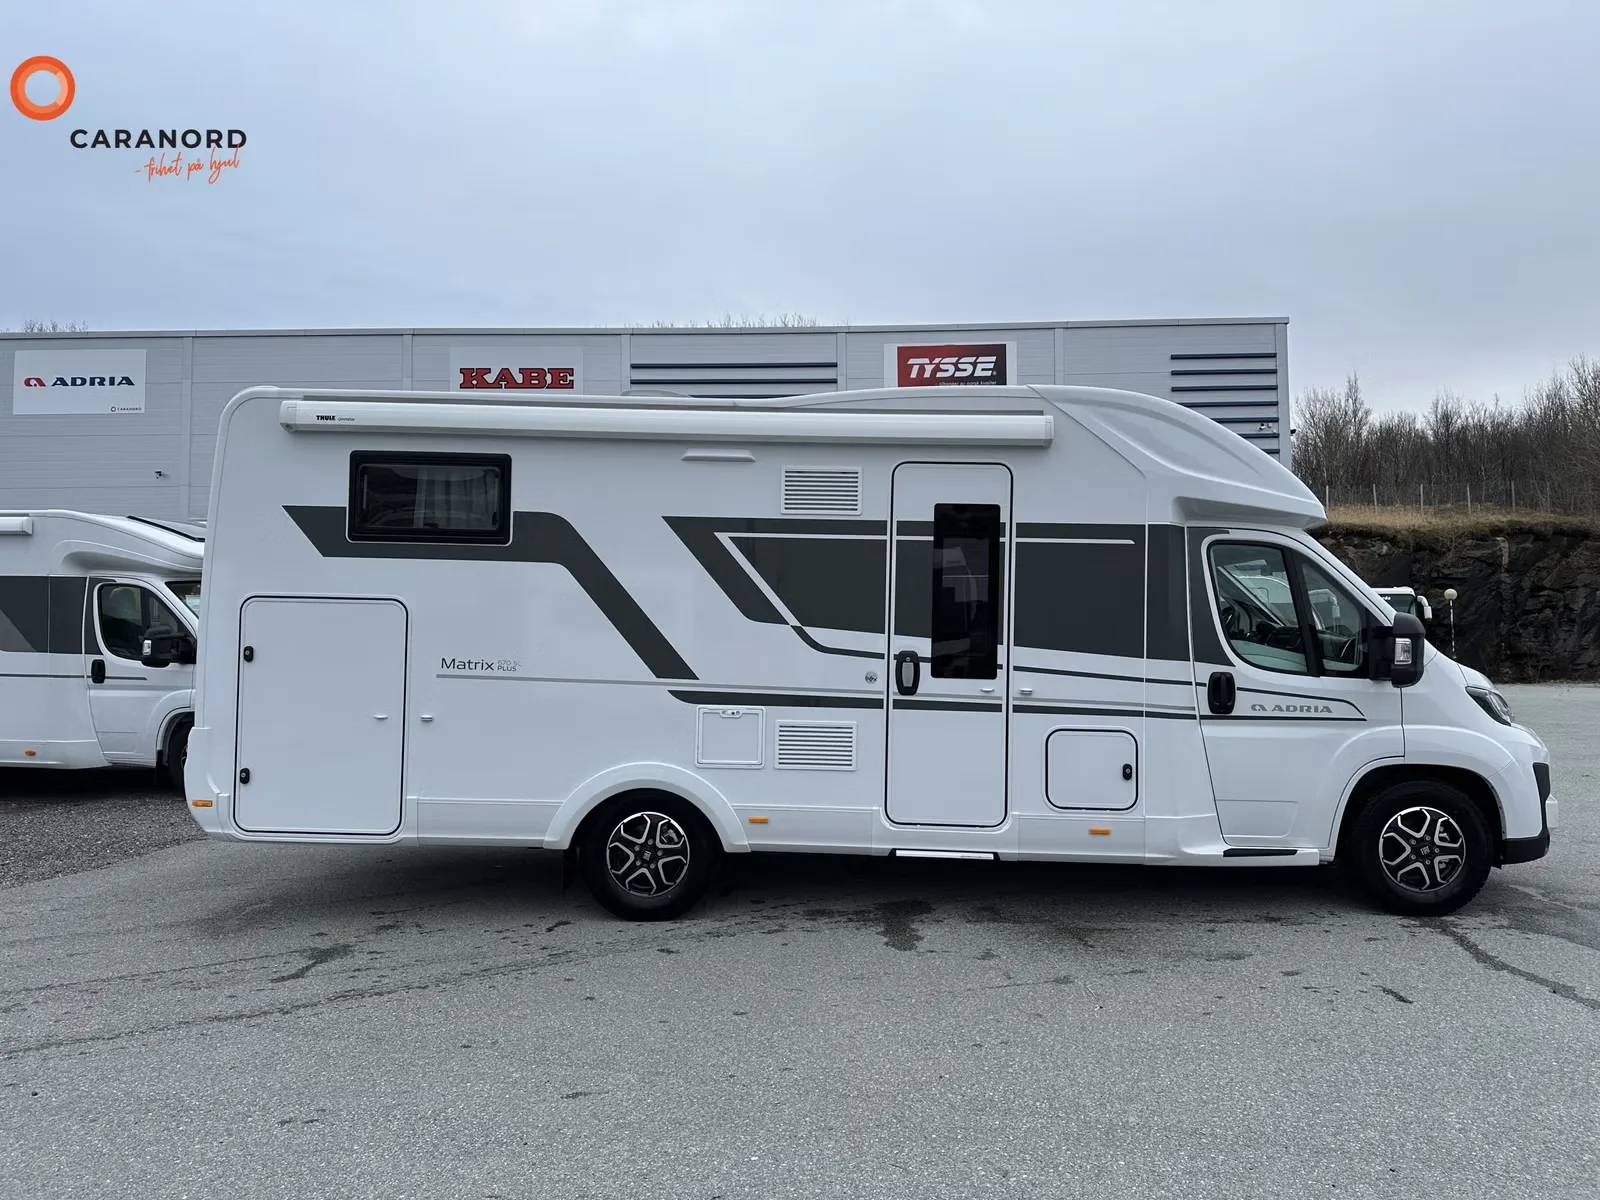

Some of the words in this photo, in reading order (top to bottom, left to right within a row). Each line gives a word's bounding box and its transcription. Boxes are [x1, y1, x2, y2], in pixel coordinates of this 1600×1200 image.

[907, 356, 996, 378] TYSSE
[51, 376, 135, 387] ADRIA
[459, 367, 574, 389] KABE
[441, 657, 495, 671] Matrix
[1271, 704, 1333, 714] ADRIA
